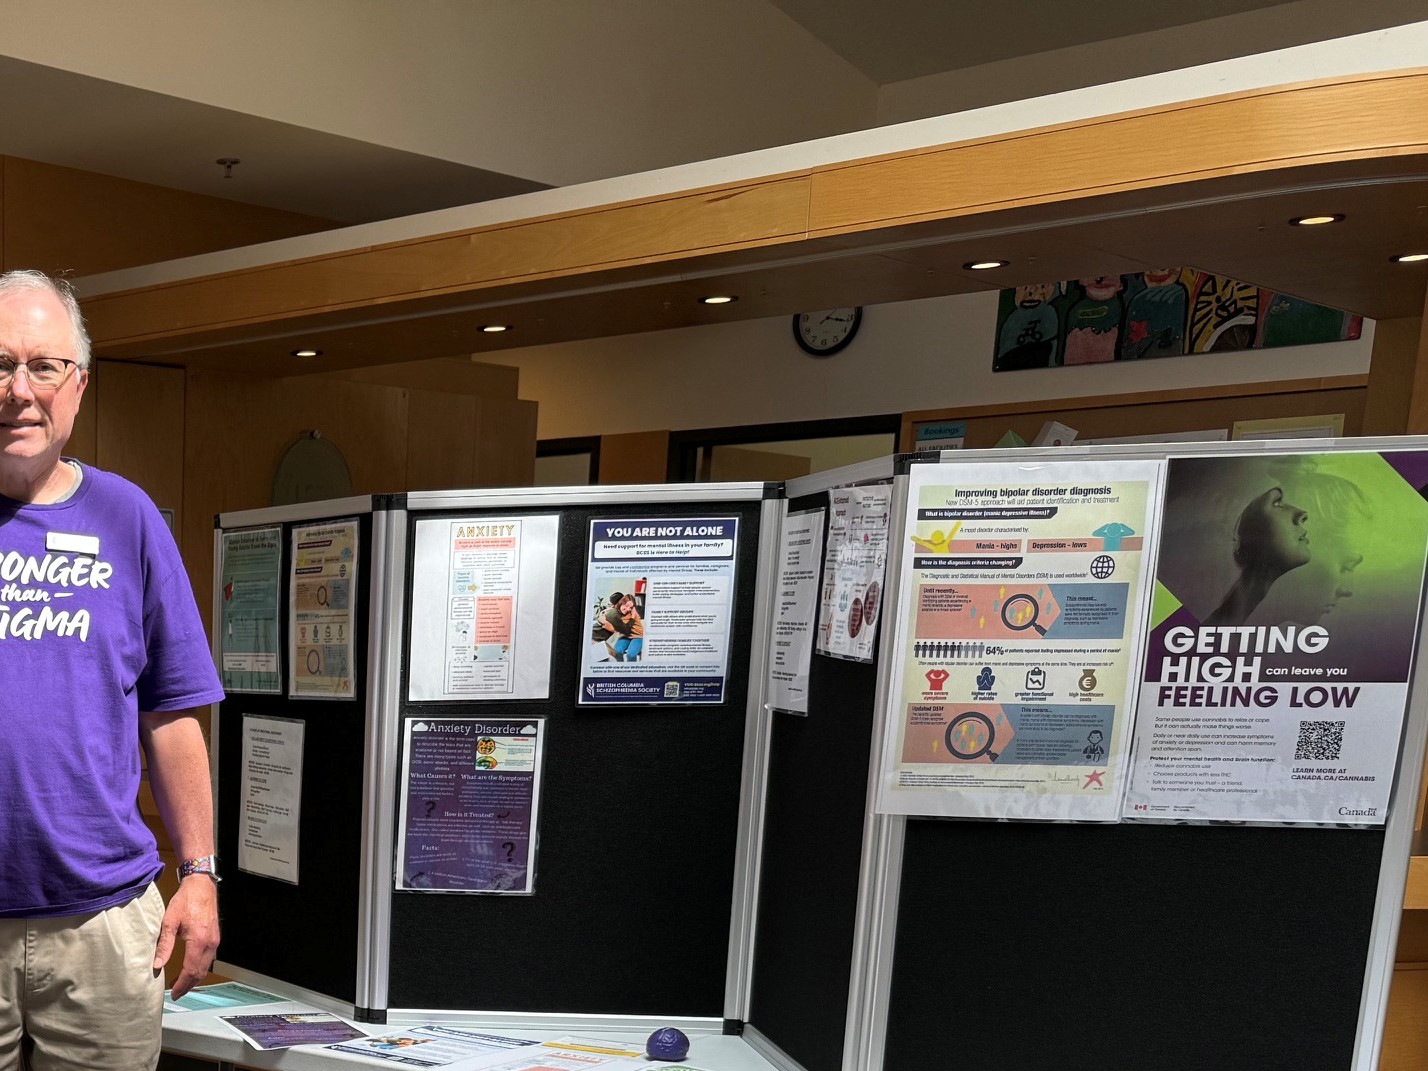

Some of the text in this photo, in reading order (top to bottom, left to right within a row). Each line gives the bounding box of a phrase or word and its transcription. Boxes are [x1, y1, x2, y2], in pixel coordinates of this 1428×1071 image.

[924, 426, 960, 436] Bookings
[955, 486, 1112, 498] Improving bipolar disorder diagnosis
[457, 525, 514, 538] ANXIETY
[606, 526, 724, 538] YOU ARE NOT ALONE
[0, 584, 51, 602] than
[1163, 626, 1330, 654] GETTING
[986, 646, 1004, 656] 64%
[1160, 656, 1348, 684] HIGH can leave you
[1157, 686, 1362, 708] FEELING LOW
[429, 722, 521, 735] Anxiety Disorder
[1338, 806, 1377, 817] Canada
